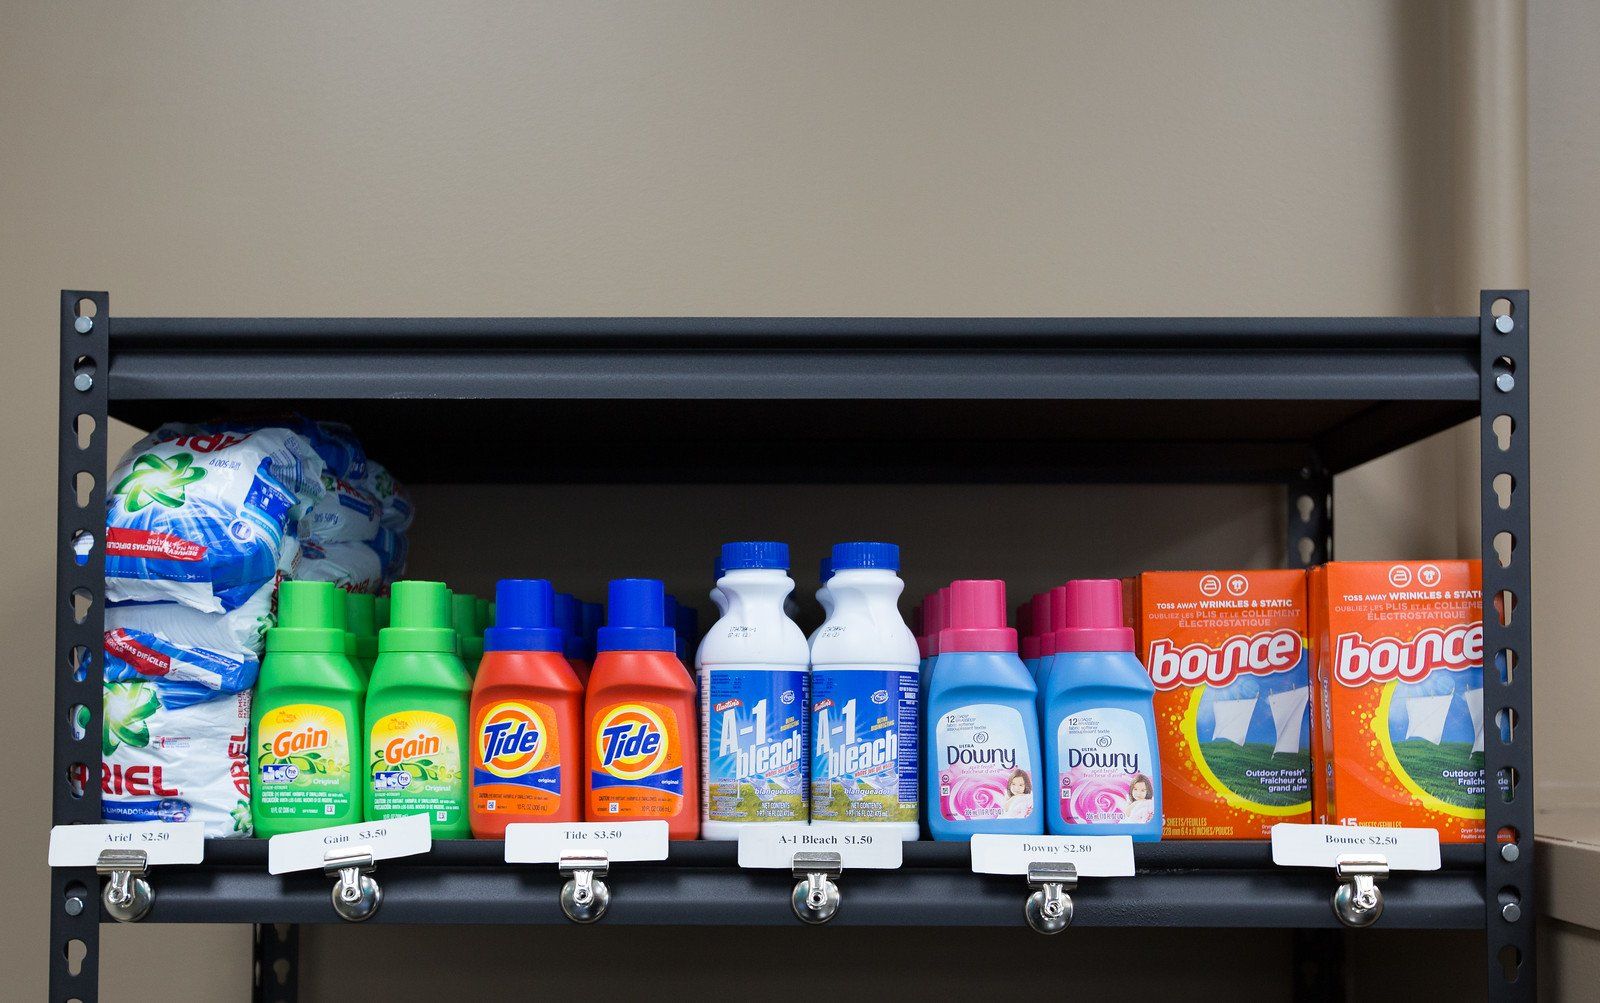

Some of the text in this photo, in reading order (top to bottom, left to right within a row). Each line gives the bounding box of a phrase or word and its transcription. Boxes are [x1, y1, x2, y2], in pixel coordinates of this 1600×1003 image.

[1343, 594, 1362, 602] TOSS
[1388, 591, 1442, 600] WRINKLES
[1454, 590, 1483, 598] STATI
[1156, 602, 1176, 610] TOSS
[1199, 600, 1249, 608] WRINKLES
[1251, 600, 1258, 608] &
[1260, 599, 1292, 608] STATIC
[1386, 602, 1408, 611] PLIS
[1148, 612, 1180, 620] OUBLIEZ
[1196, 610, 1216, 618] PLIS
[1241, 609, 1301, 618] COLLEMENT
[1367, 610, 1466, 621] ÉLECTROSTATIQUE
[1178, 618, 1272, 628] ÉLECTROSTATIQUE
[1338, 624, 1483, 681] bounce
[1151, 632, 1296, 685] bounce
[946, 716, 955, 724] 12
[1068, 718, 1078, 726] 12
[718, 698, 766, 758] A-1
[816, 698, 856, 758] A-1
[273, 726, 328, 758] Gain
[484, 721, 540, 764] Tide
[602, 723, 661, 766] Tide
[385, 733, 440, 765] Gain
[736, 729, 802, 780] bleach
[828, 729, 898, 780] bleach
[946, 746, 1016, 770] Downy
[1068, 748, 1138, 775] Downy
[1442, 770, 1477, 778] Outdoor
[312, 778, 340, 786] Original
[424, 785, 452, 793] Original
[844, 788, 890, 796] blanqueador
[1268, 784, 1291, 793] grand
[1166, 818, 1207, 826] SHEETS/FEUILLES
[564, 830, 622, 840] Tide $3.50
[1196, 826, 1234, 835] INCHES/POUCES
[104, 832, 170, 842] Ariel $2.50
[324, 828, 387, 845] Gain $3.50
[778, 835, 872, 844] A-1 Bleach $1.50
[1326, 835, 1398, 845] Bounce $2.50
[1023, 844, 1092, 854] Downy $2.80
